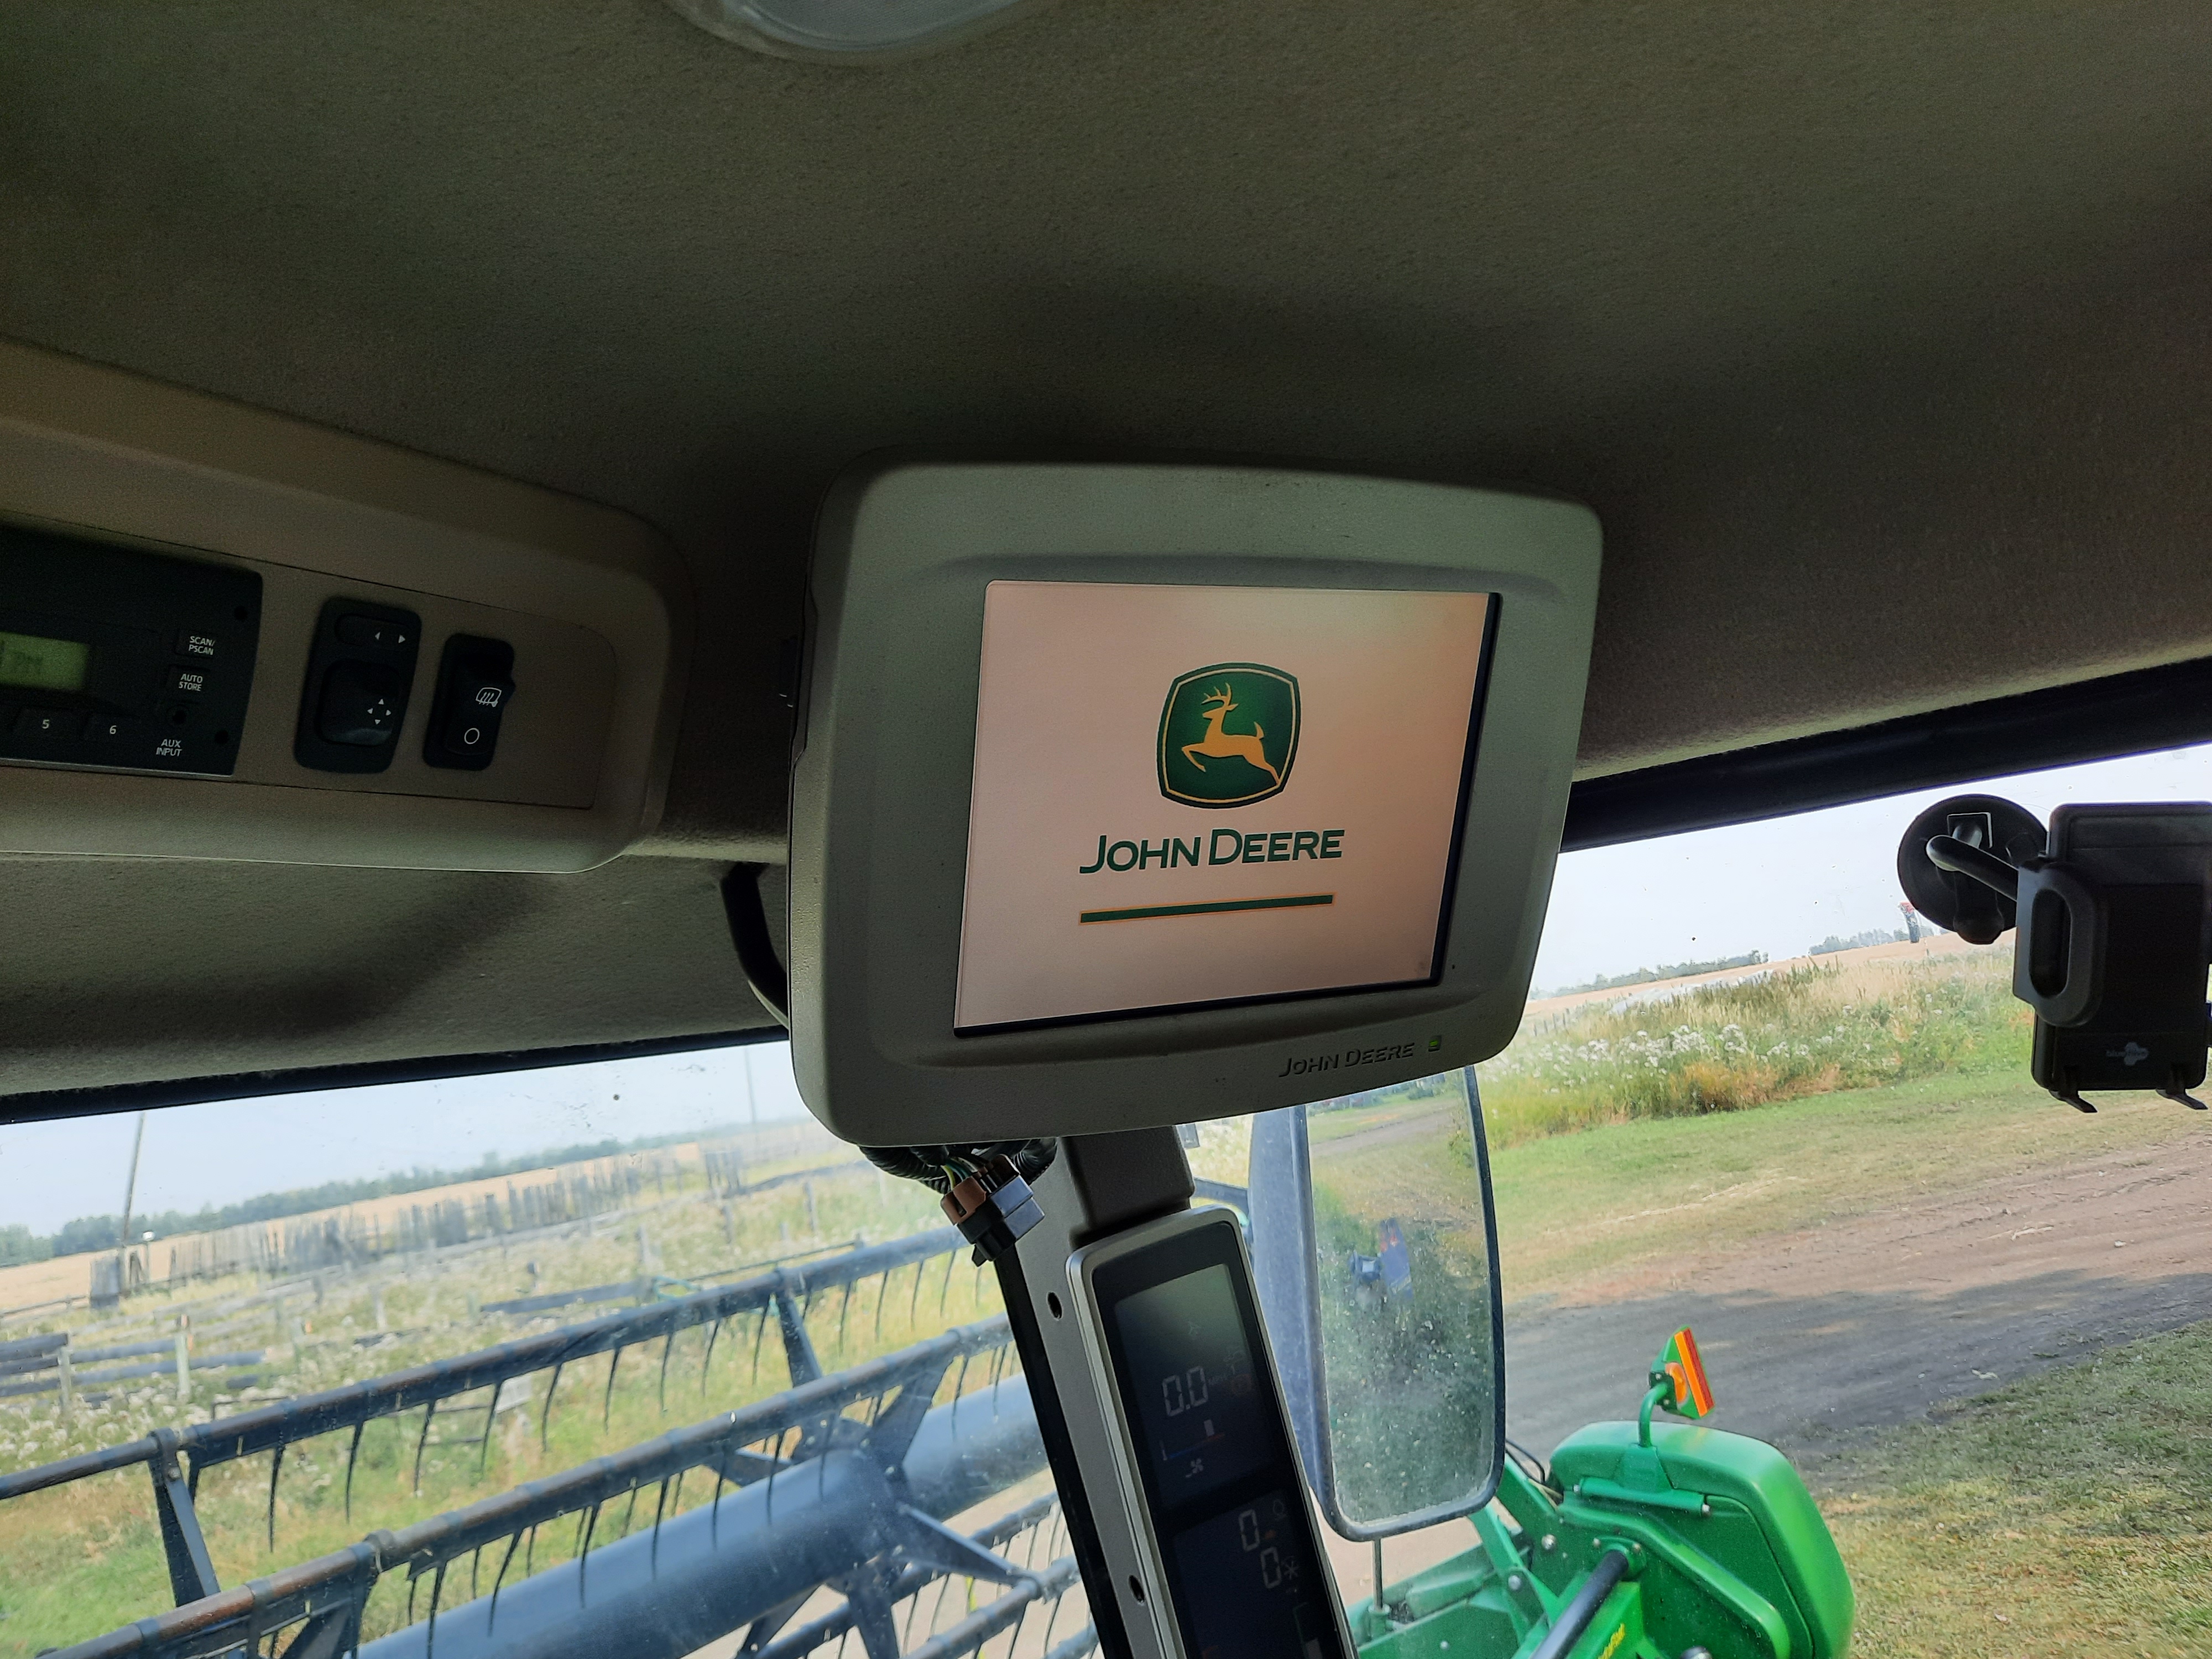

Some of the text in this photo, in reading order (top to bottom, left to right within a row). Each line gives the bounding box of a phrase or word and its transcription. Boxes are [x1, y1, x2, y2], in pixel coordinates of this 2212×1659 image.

[189, 635, 216, 646] SCAN/
[188, 644, 214, 655] PSCAN
[180, 674, 203, 684] AUTO
[178, 681, 202, 691] STORE
[41, 719, 50, 729] 5
[109, 725, 117, 734] 6
[161, 739, 181, 748] AUX
[155, 747, 182, 757] INPUT
[1079, 828, 1345, 874] JOHN DEERE
[1278, 1042, 1415, 1078] JOHN DEERE
[1162, 1365, 1208, 1417] 0.0
[1238, 1509, 1260, 1552] 0
[1260, 1546, 1282, 1589] 0
